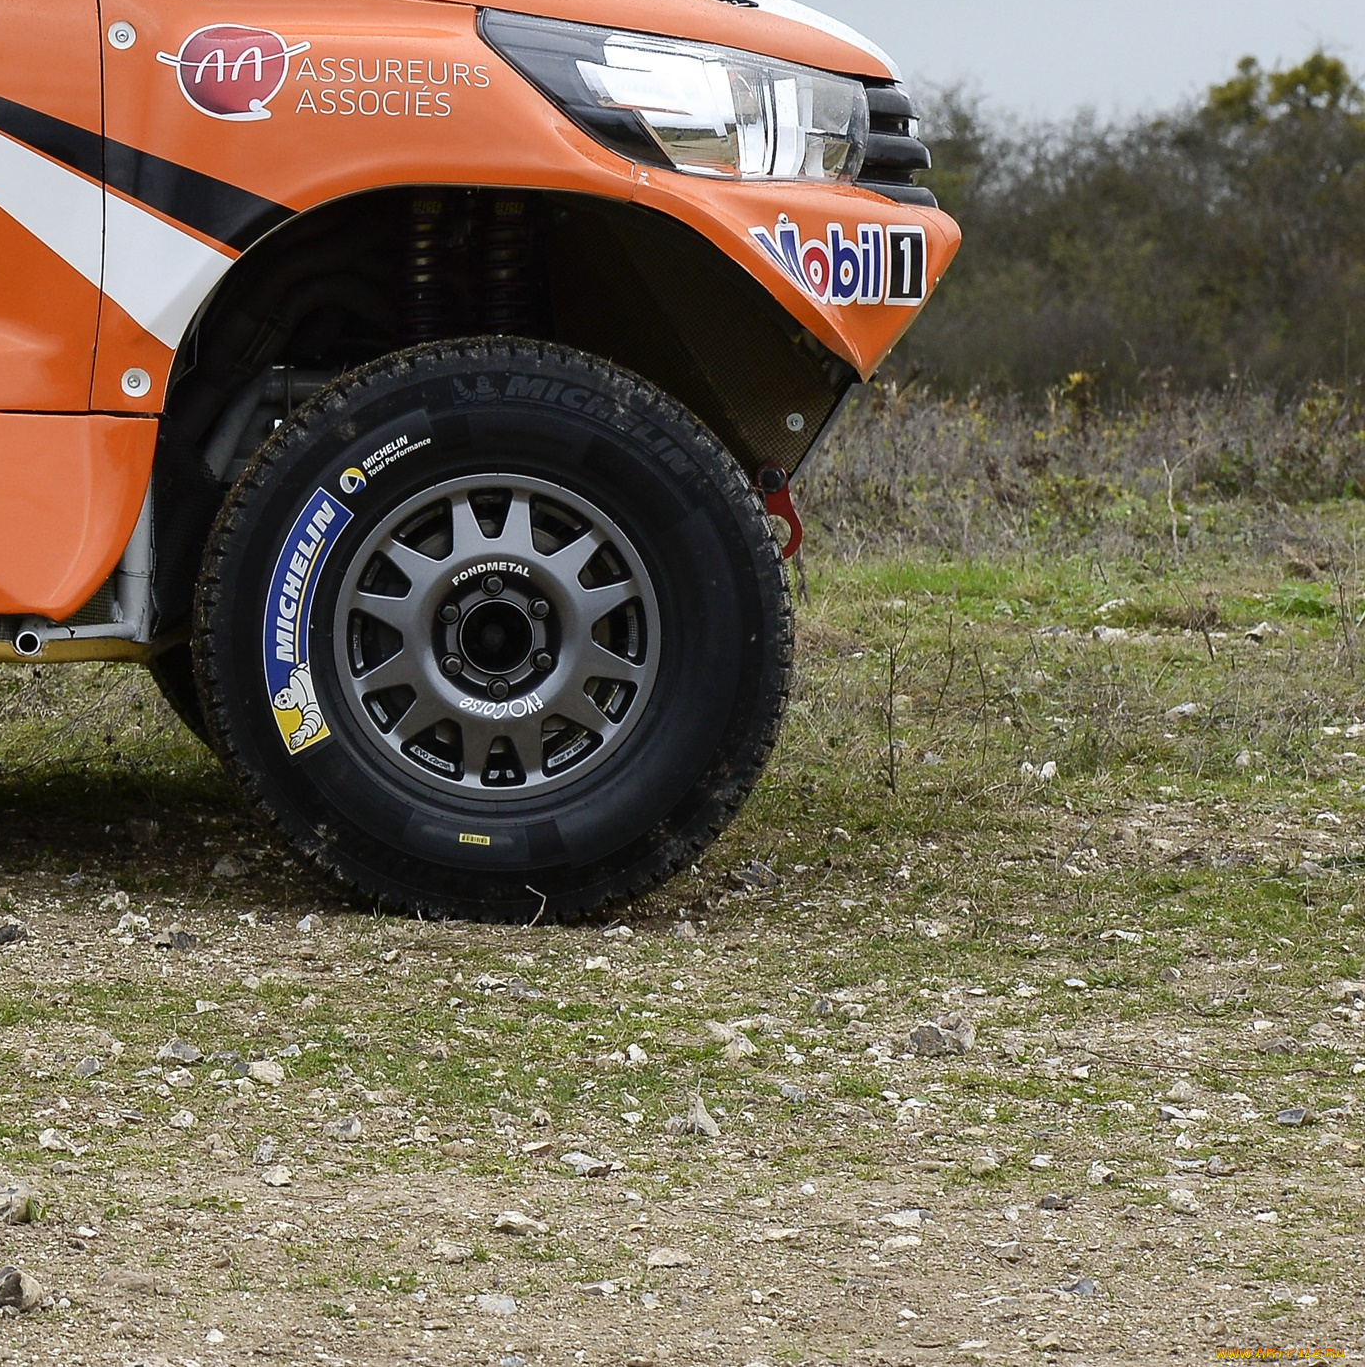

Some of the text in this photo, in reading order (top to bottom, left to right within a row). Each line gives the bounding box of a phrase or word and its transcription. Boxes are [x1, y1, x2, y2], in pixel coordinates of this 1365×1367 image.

[295, 56, 491, 89] ASSUREURS
[295, 85, 452, 118] ASSOCIÉS
[754, 228, 882, 299] Mobil
[361, 434, 409, 471] MICHELIN
[367, 437, 432, 478] Total Performance
[275, 499, 337, 664] MICHELIN
[451, 561, 530, 587] FONDMETAL
